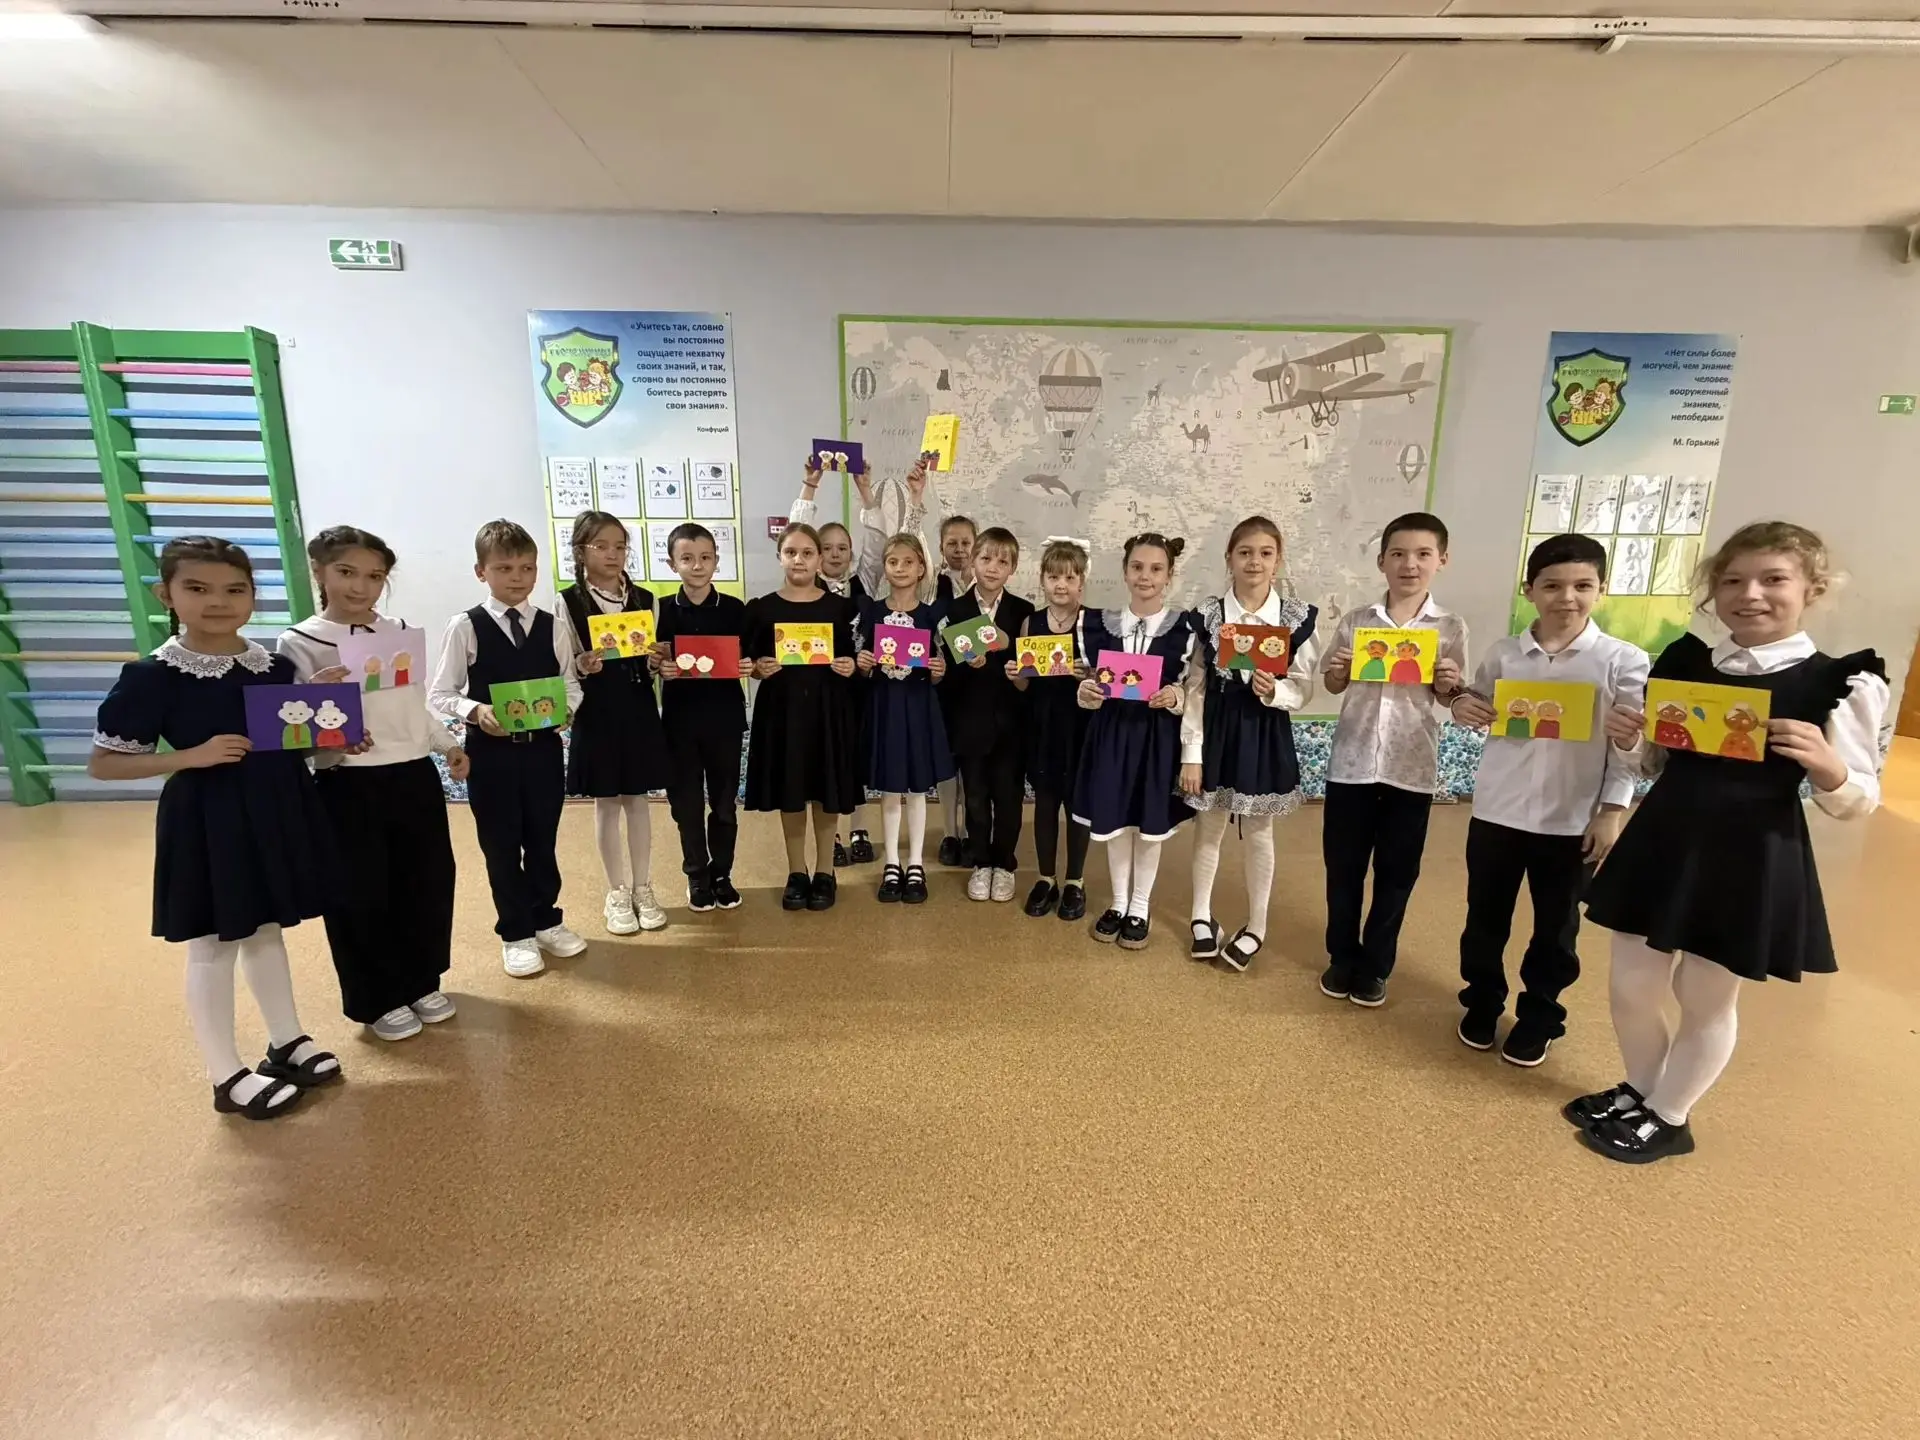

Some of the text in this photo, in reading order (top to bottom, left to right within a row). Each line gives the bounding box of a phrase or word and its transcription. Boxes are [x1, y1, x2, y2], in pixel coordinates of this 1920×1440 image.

[630, 321, 724, 332] «Учитесь так, словно
[677, 337, 725, 345] постоянно
[637, 350, 725, 359] ощущаете нехватку
[1664, 348, 1686, 357] «Нет
[1710, 348, 1737, 357] более
[663, 361, 699, 372] знаний,
[708, 363, 726, 372] так,
[631, 376, 727, 384] словно вы постоянно
[646, 387, 727, 398] боитесь растерять
[1669, 387, 1729, 397] вооруженный
[665, 402, 728, 410] свои знания».
[1193, 409, 1302, 421] RUSSIA
[696, 425, 729, 434] Конфуций
[1672, 438, 1720, 448] М. Горький
[1263, 479, 1296, 488] CHINA
